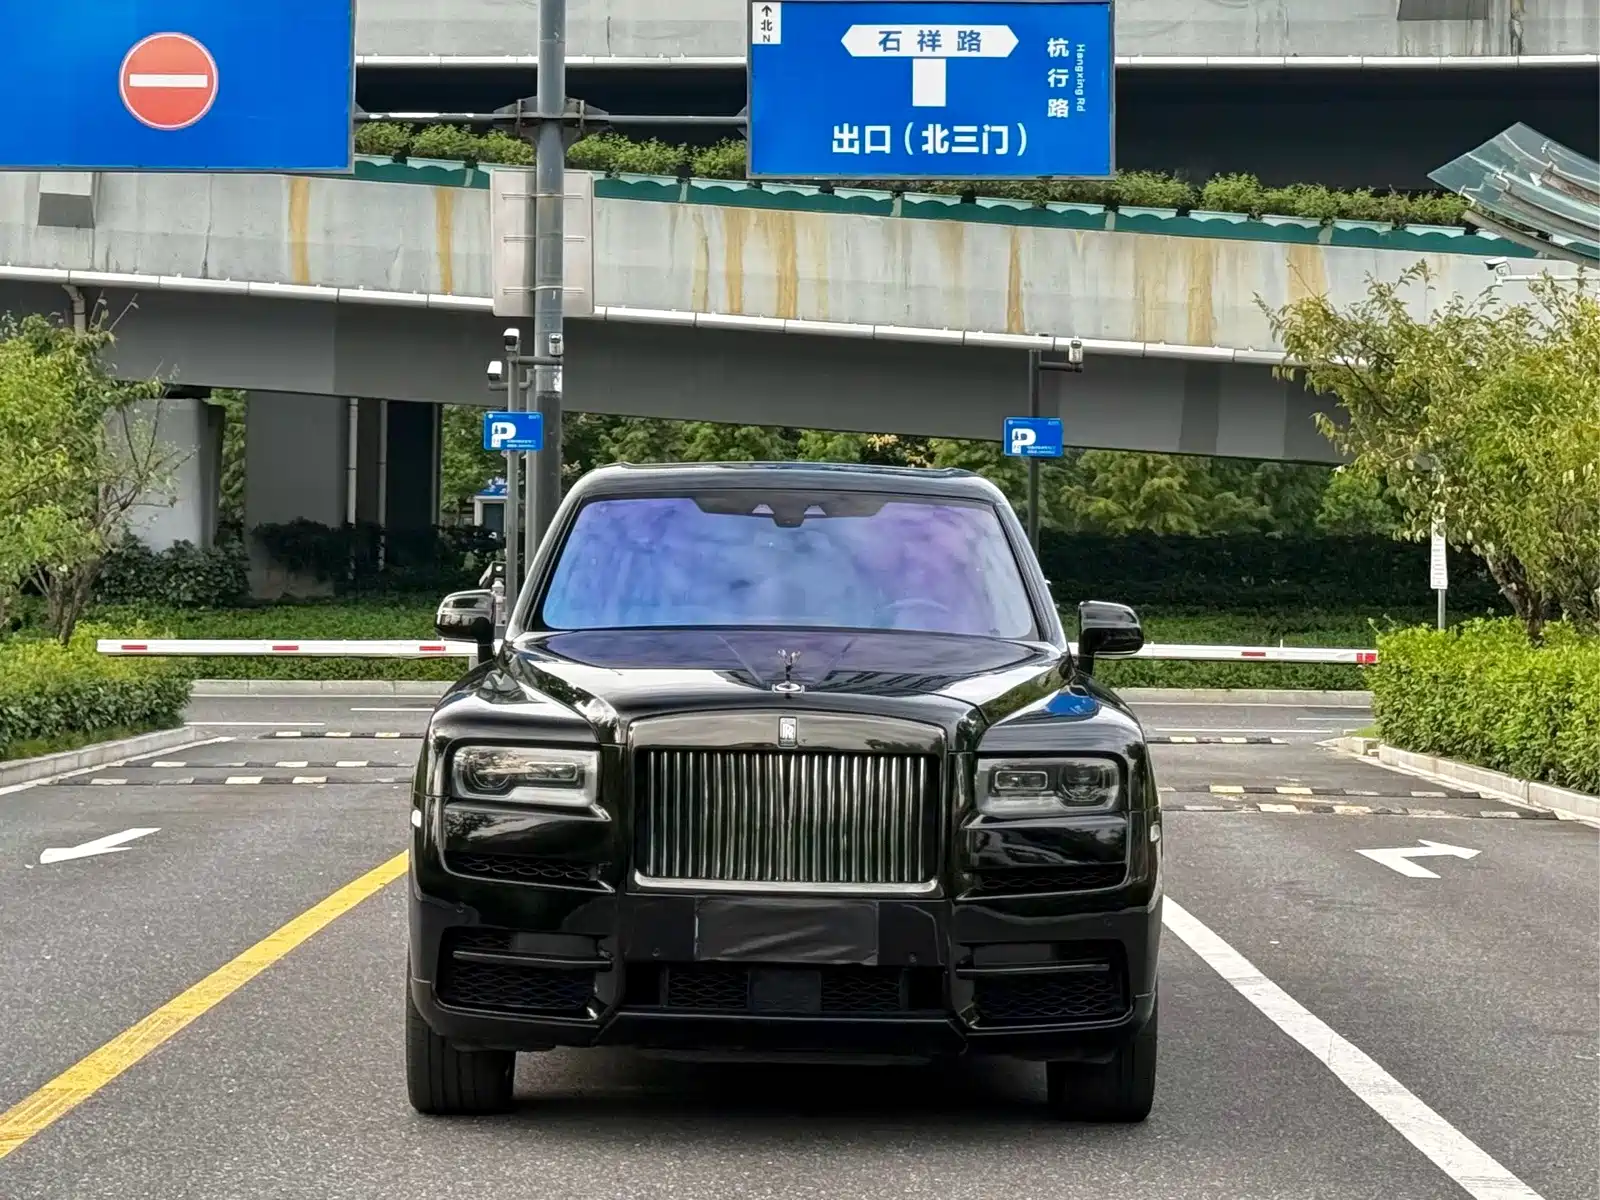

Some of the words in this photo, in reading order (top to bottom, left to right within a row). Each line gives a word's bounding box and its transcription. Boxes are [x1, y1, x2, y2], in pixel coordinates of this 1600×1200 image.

[760, 19, 773, 32] 北
[762, 34, 771, 43] N
[878, 30, 982, 53] 石祥路
[1047, 37, 1069, 118] 杭行路
[1074, 44, 1086, 96] Hangxing
[1076, 97, 1086, 112] Rd
[832, 122, 1028, 156] 出口（北三门）
